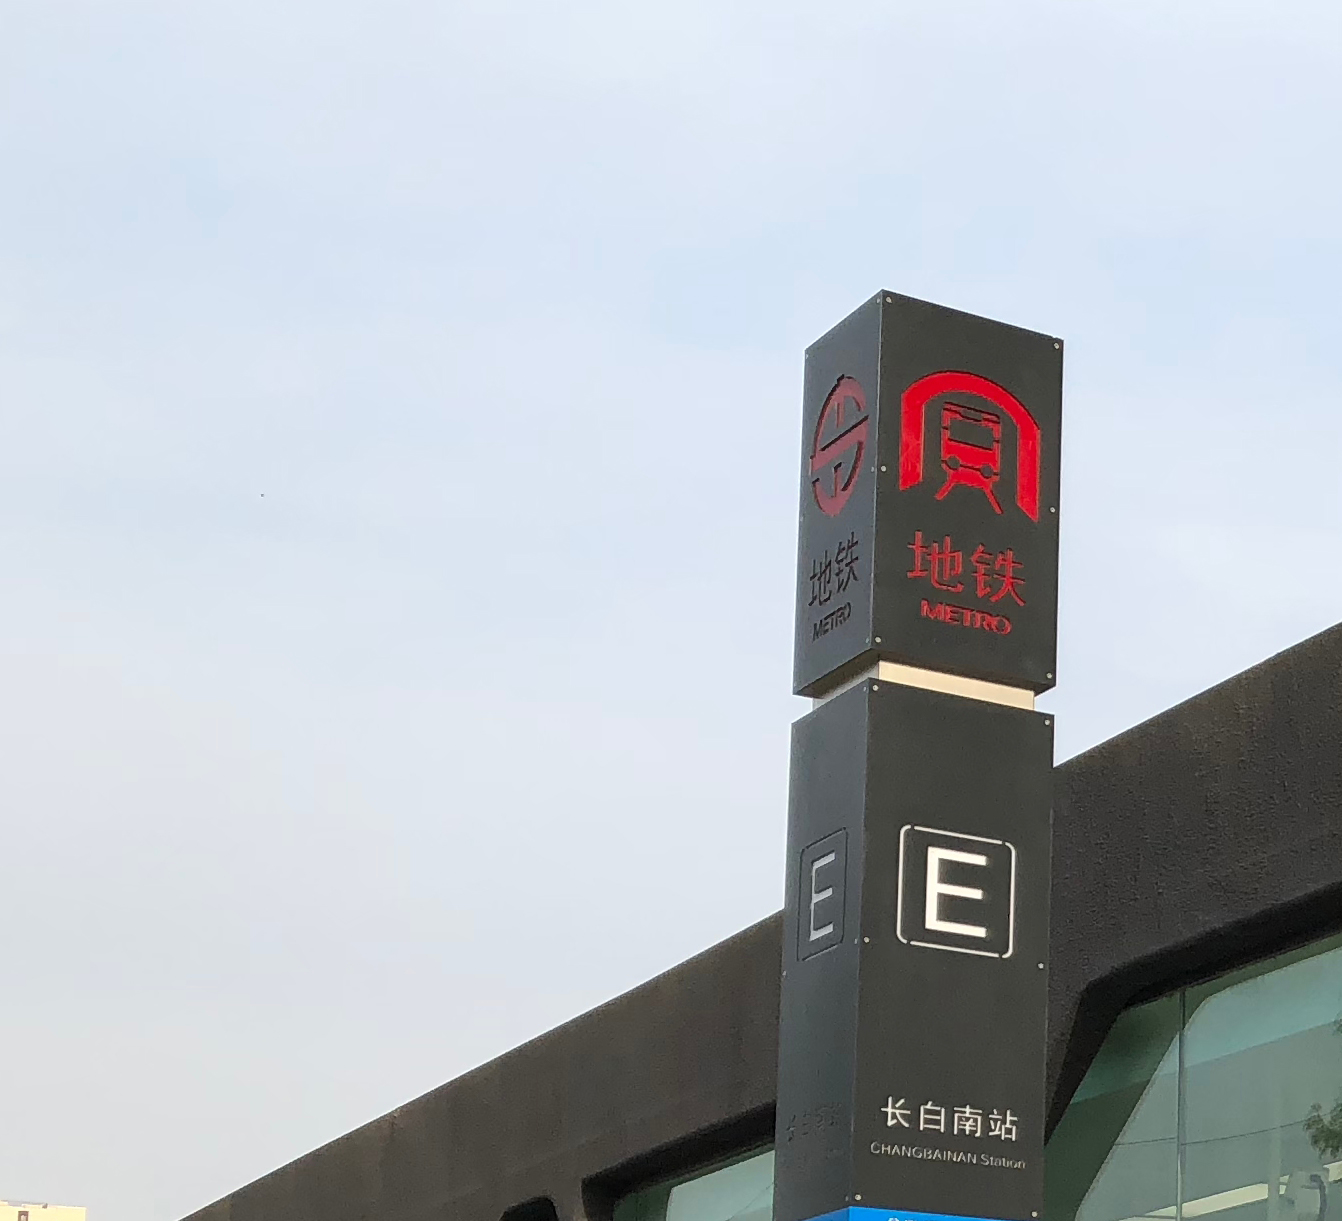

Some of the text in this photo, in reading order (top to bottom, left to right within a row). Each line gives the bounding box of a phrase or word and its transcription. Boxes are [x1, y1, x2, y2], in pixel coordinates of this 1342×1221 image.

[808, 531, 860, 608] 地铁
[906, 530, 1026, 606] 地铁
[812, 601, 852, 642] METRO
[920, 600, 1012, 635] METRO
[809, 851, 836, 942] E
[925, 845, 987, 938] E
[881, 1096, 1018, 1142] 长白南站
[870, 1142, 1026, 1169] CHANGBAINAN Station
